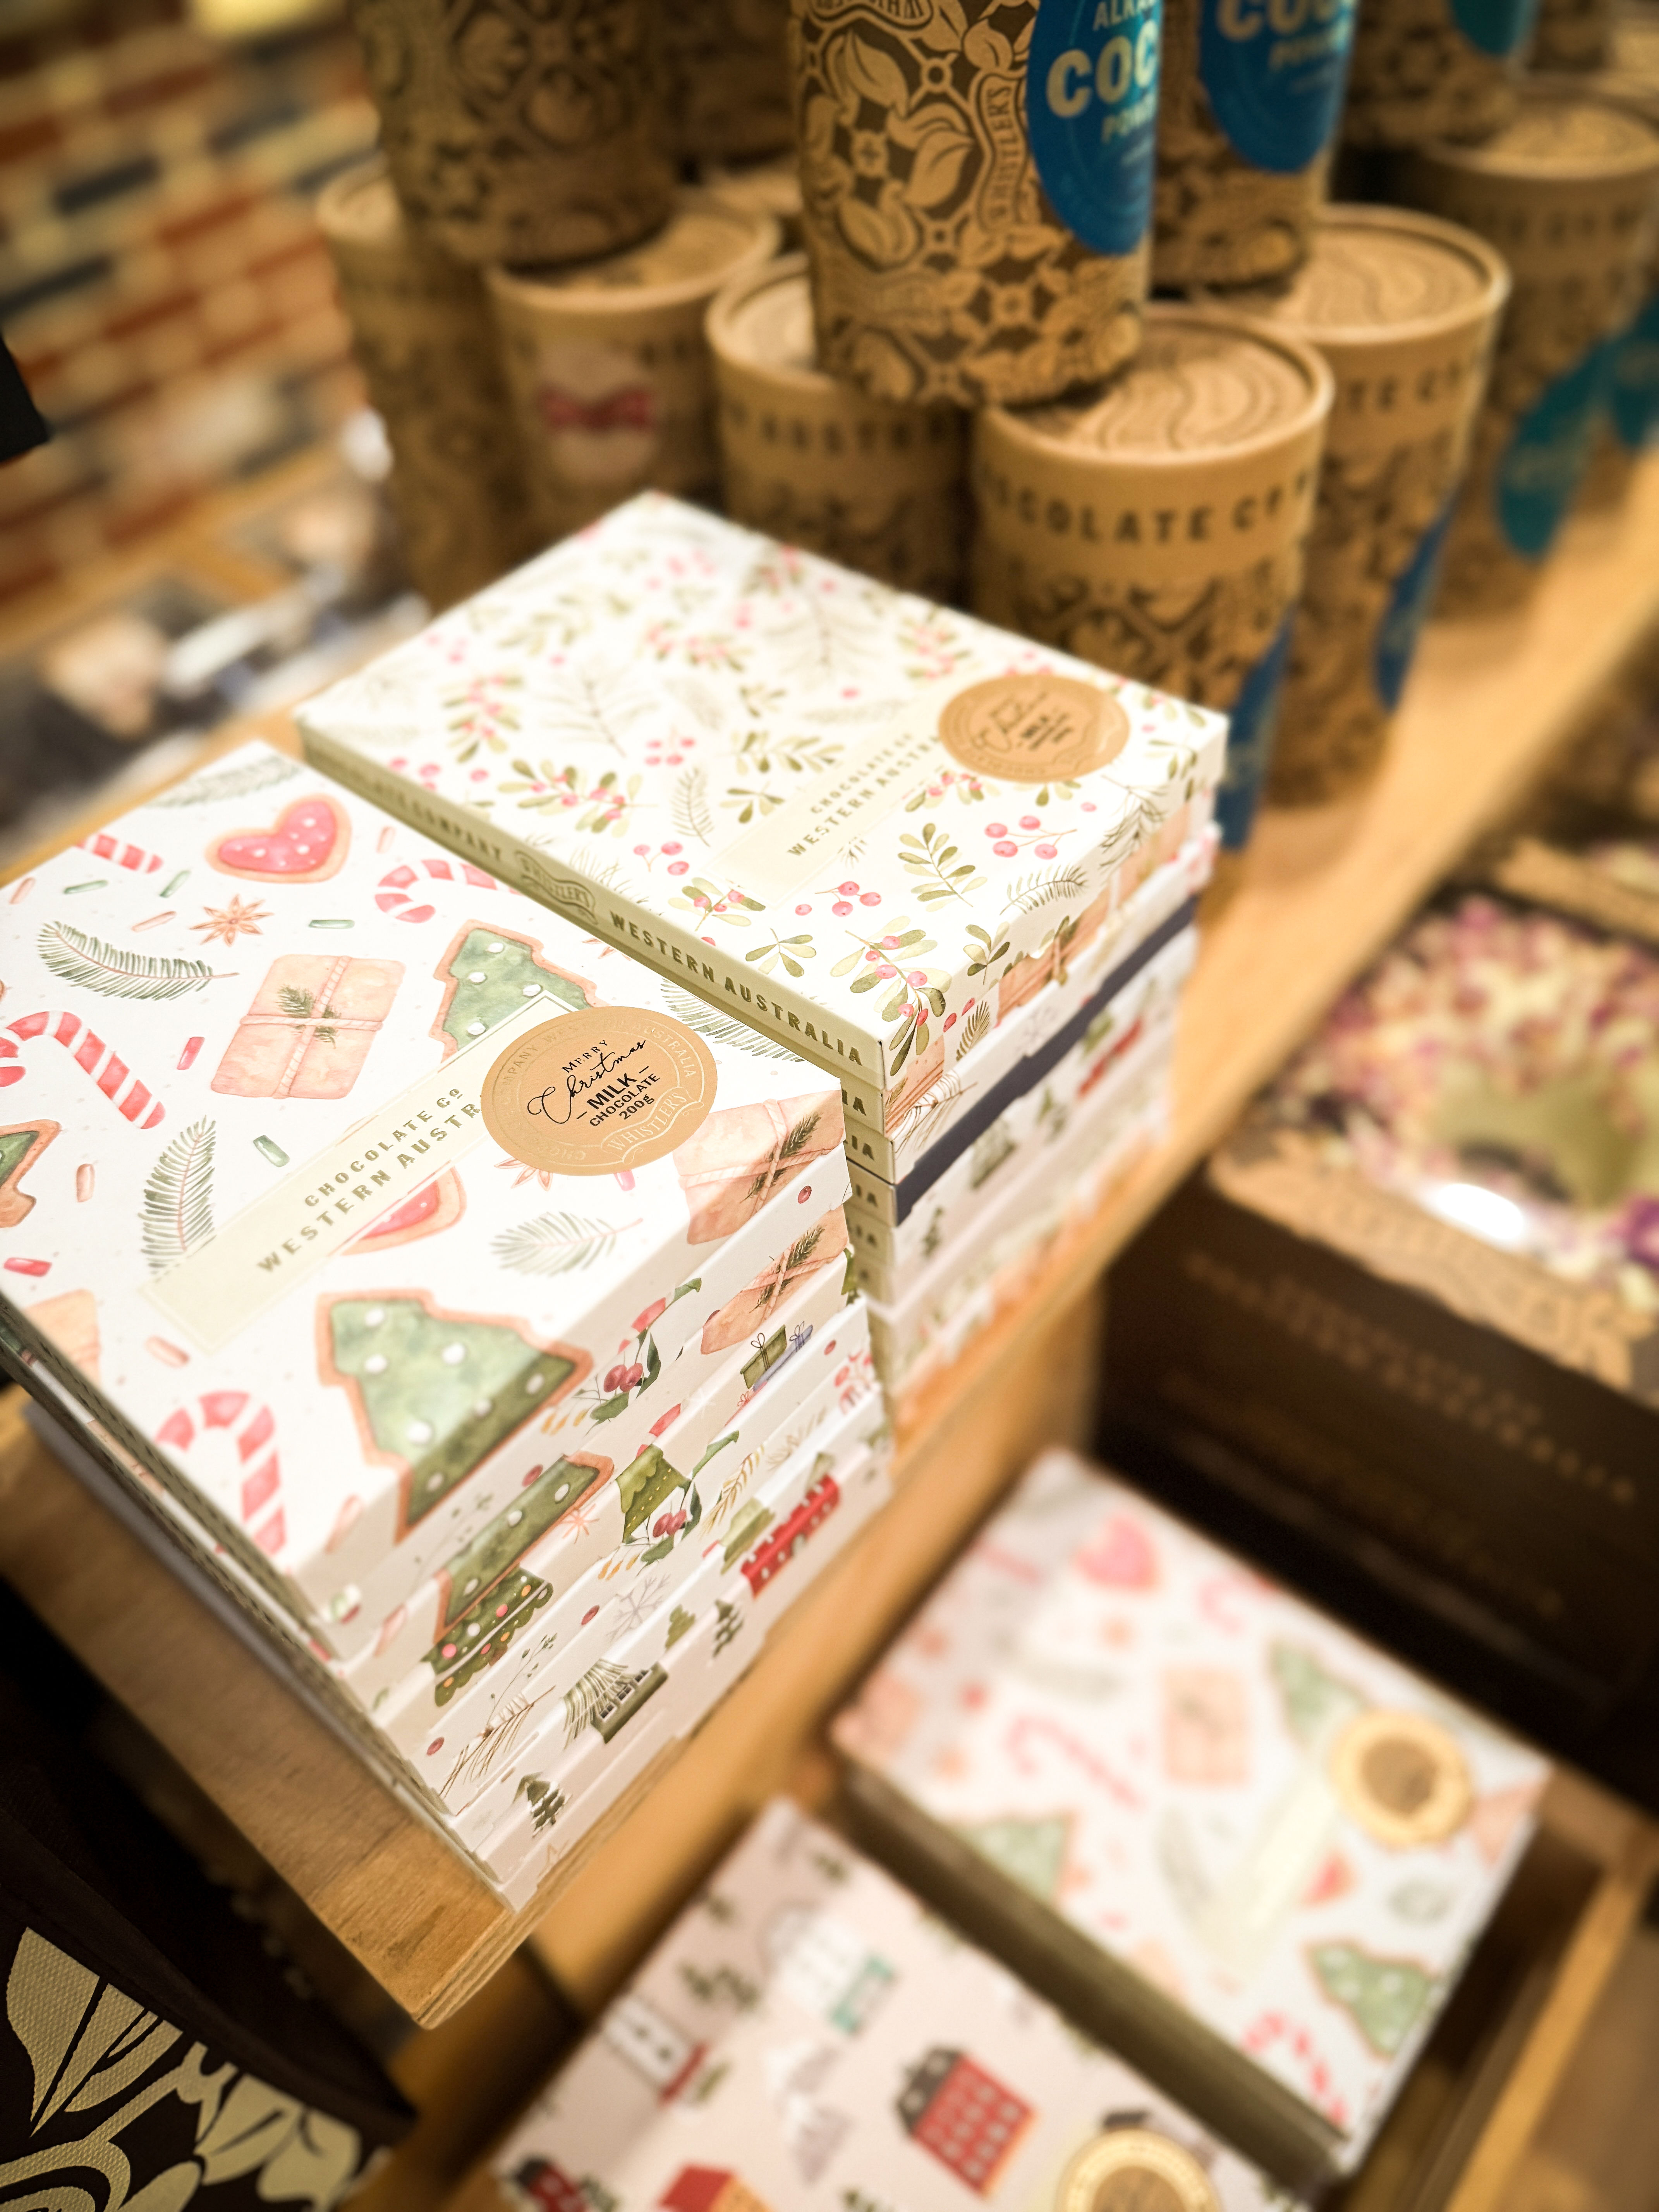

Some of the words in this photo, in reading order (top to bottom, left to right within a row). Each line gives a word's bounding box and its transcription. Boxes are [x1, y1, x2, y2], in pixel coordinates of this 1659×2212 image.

[787, 788, 874, 856] WESTERN
[610, 910, 715, 983] WESTERN
[725, 976, 862, 1066] AUSTRALIA
[527, 1040, 646, 1124] Christmas
[562, 1040, 608, 1073] MERRY
[586, 1072, 638, 1110] MILK
[589, 1073, 661, 1127] CHOCOLATE
[607, 1092, 687, 1151] WHISTLER'S
[618, 1094, 655, 1120] 200g
[257, 1169, 392, 1273] WESTERN
[397, 1103, 483, 1169] AUSTR
[305, 1110, 433, 1207] CHOCOLATE
